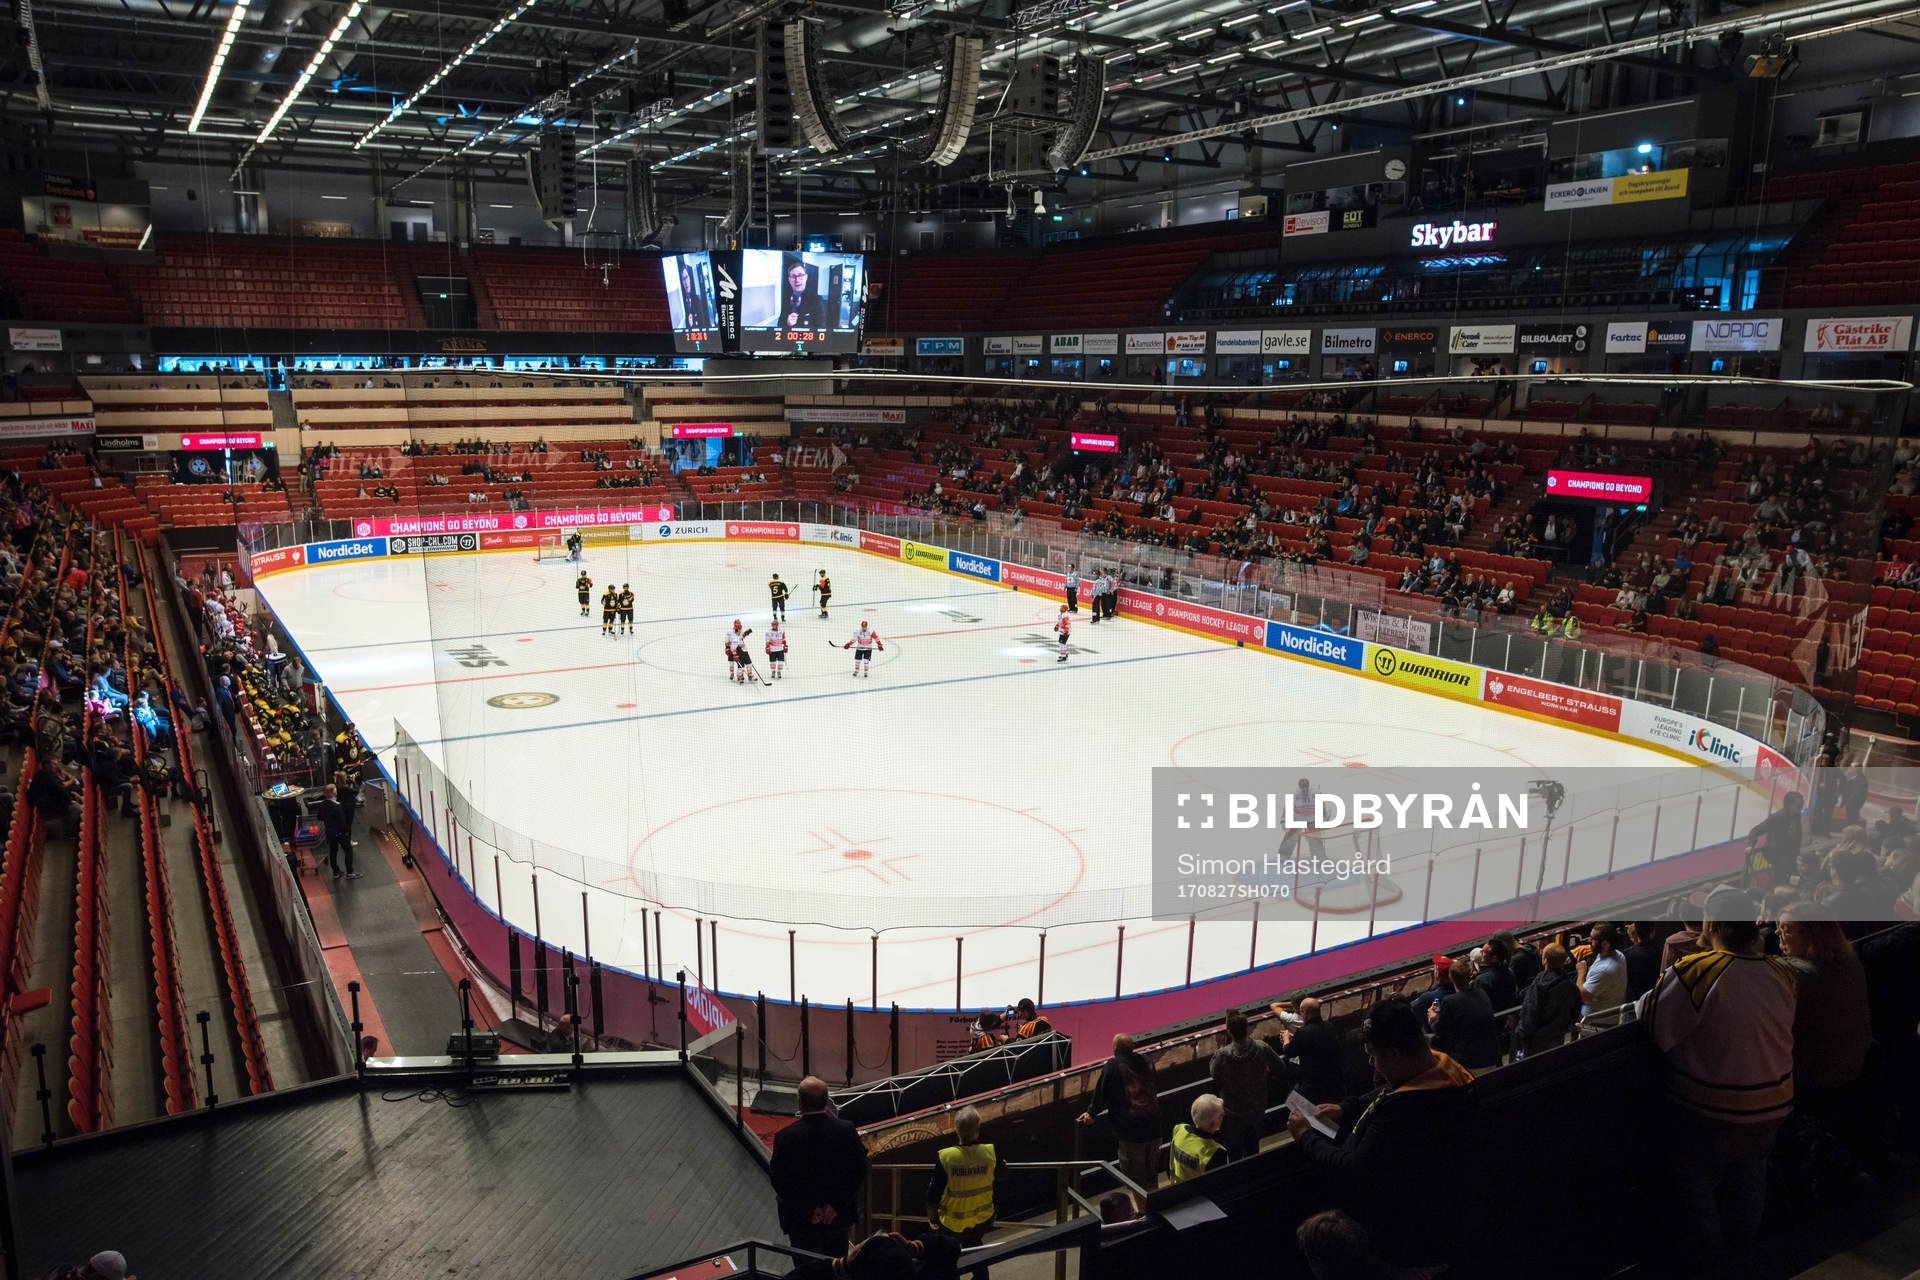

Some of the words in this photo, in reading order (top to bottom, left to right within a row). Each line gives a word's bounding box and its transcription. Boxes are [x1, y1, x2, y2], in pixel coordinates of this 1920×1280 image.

[1550, 189, 1577, 199] ECKERÖ
[1584, 186, 1609, 196] LINJEN
[1295, 216, 1328, 228] Revision
[1411, 220, 1497, 249] Skybar
[728, 304, 736, 339] MIDROC
[1705, 322, 1769, 338] NORDIC
[1833, 323, 1892, 335] Gästrike
[787, 333, 814, 341] 00:28
[819, 333, 825, 341] 0
[1054, 336, 1079, 347] ABAB
[1217, 339, 1260, 347] Handelsbanken
[1264, 333, 1307, 350] gavle.se
[1324, 334, 1372, 348] Bilmetro
[1394, 332, 1434, 341] ENERCO
[1521, 334, 1574, 344] BILBOLAGET
[1658, 333, 1686, 341] KUSBO
[1835, 334, 1862, 345] Plåt
[1865, 334, 1889, 346] AB
[921, 342, 960, 350] TPM
[1462, 340, 1479, 348] Cater
[100, 438, 140, 448] Lindholms
[1568, 479, 1605, 491] CHAMPIONS
[1605, 482, 1615, 491] GO
[1616, 483, 1642, 494] BEYOND
[545, 513, 595, 526] CHAMPIONS
[597, 511, 609, 523] GO
[610, 511, 643, 522] BEYOND
[390, 519, 445, 533] CHAMPIONS
[448, 519, 460, 530] GO
[462, 518, 499, 530] BEYOND
[674, 527, 708, 535] ZURICH
[741, 526, 775, 535] CHAMPIONS
[407, 535, 458, 547] SHOP-CHL.COM
[318, 543, 374, 559] NordicBet
[254, 551, 287, 566] STRAUSS
[956, 556, 992, 576] NordicBet
[1010, 571, 1035, 585] CHAMPIONS
[1035, 577, 1053, 589] HOCKEY
[1132, 598, 1153, 611] LEAGUE
[1168, 607, 1201, 624] CHAMPIONS
[1202, 613, 1225, 629] HOCKEY
[1226, 619, 1249, 634] LEAGUE
[1280, 630, 1347, 661] NordicBet
[1398, 661, 1471, 687] WARRIOR
[1506, 685, 1565, 703] ENGELBERT
[1566, 698, 1617, 716] STRAUSS
[1541, 701, 1578, 714] WORKWEAR
[1654, 715, 1683, 728] EUROPE'S
[1649, 728, 1661, 738] EYE
[1662, 731, 1681, 742] CLINIC
[1656, 723, 1682, 734] LEADING
